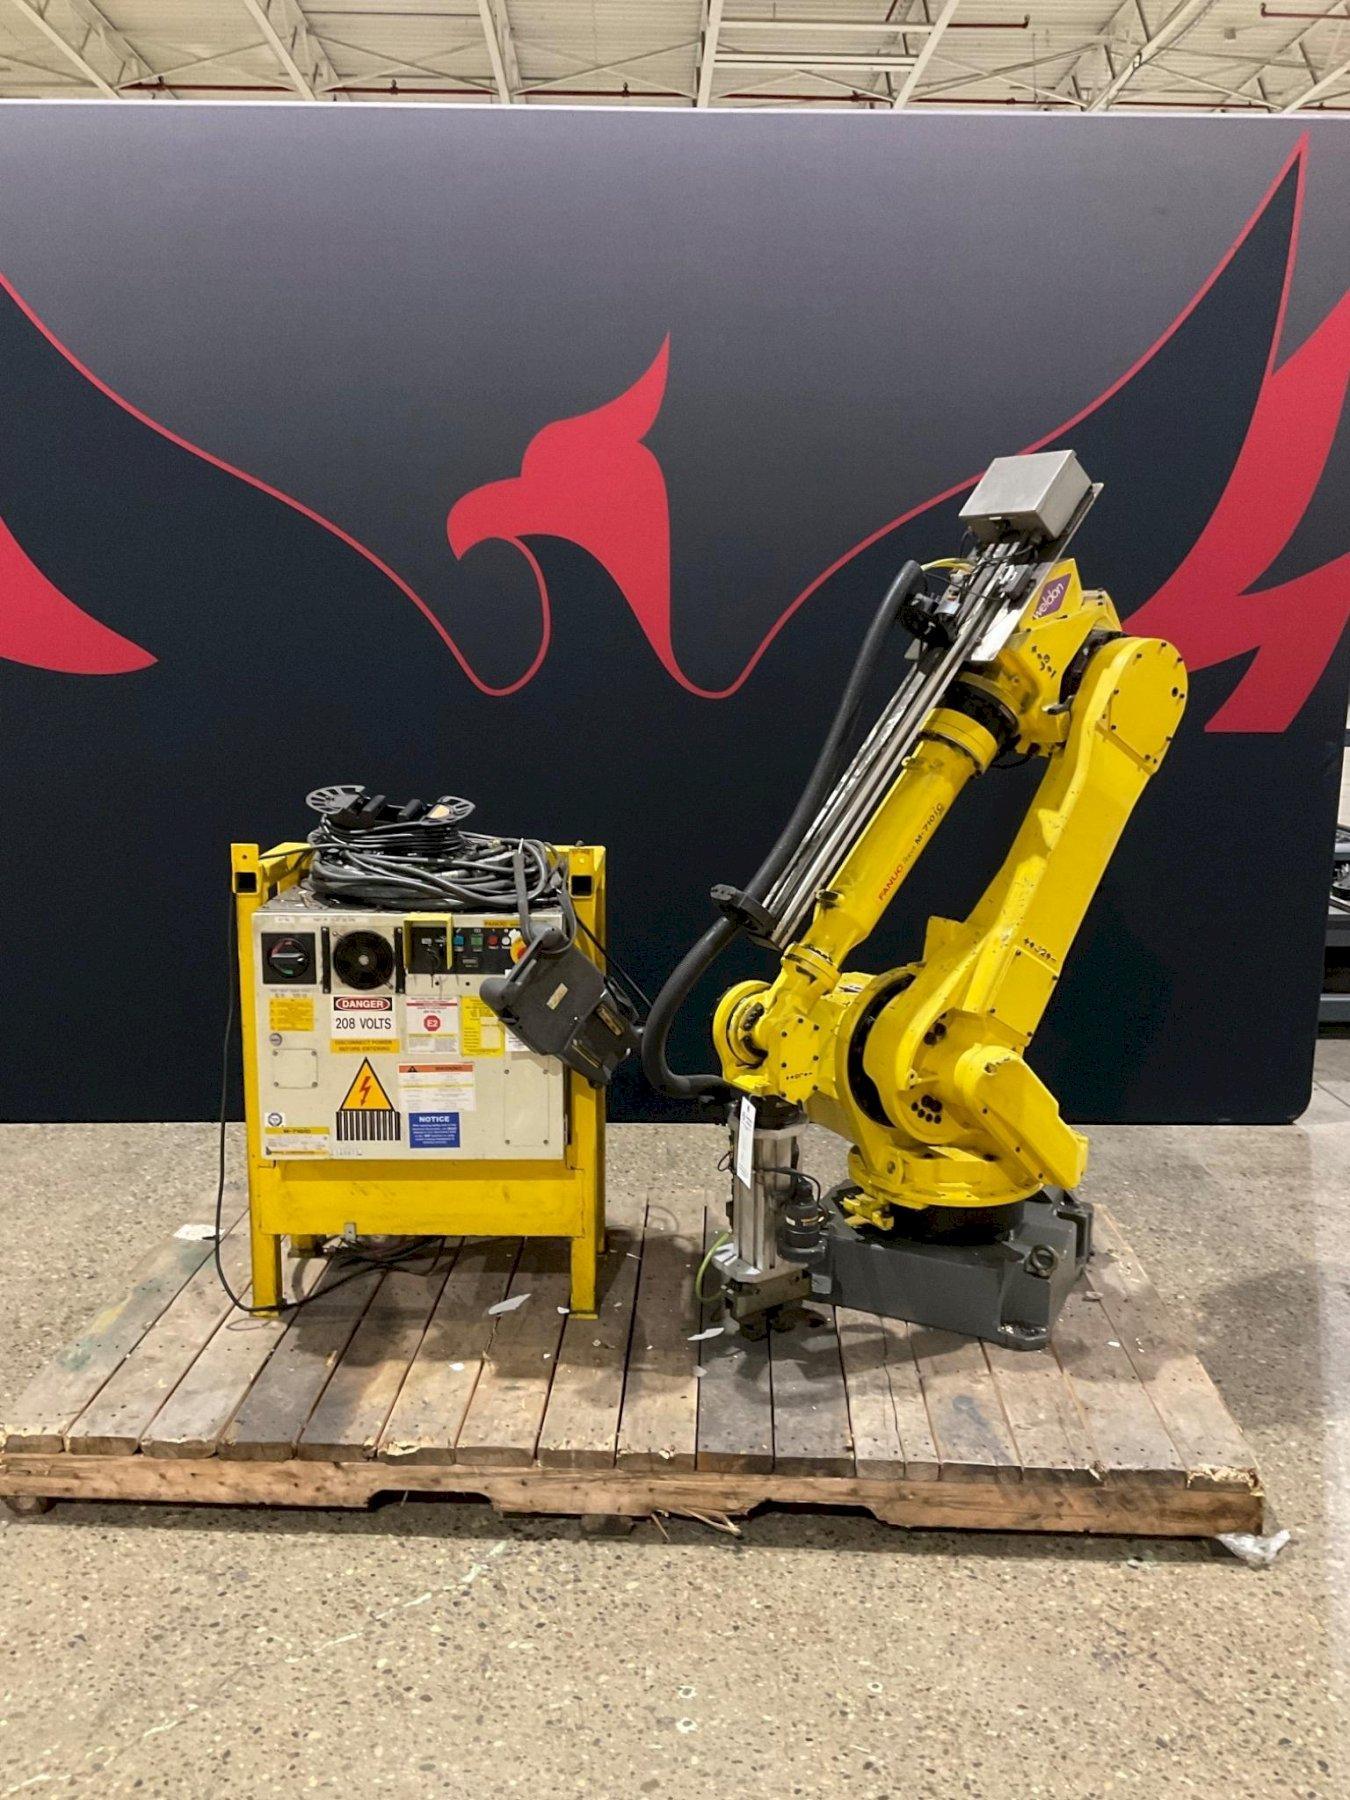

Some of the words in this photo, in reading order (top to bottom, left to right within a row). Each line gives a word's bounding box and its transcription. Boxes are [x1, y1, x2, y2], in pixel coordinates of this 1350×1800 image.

[878, 864, 904, 901] FANUC
[341, 1000, 384, 1009] DANGER
[335, 1017, 356, 1030] 208
[359, 1017, 392, 1030] VOLTS
[418, 1115, 450, 1123] NOTICE
